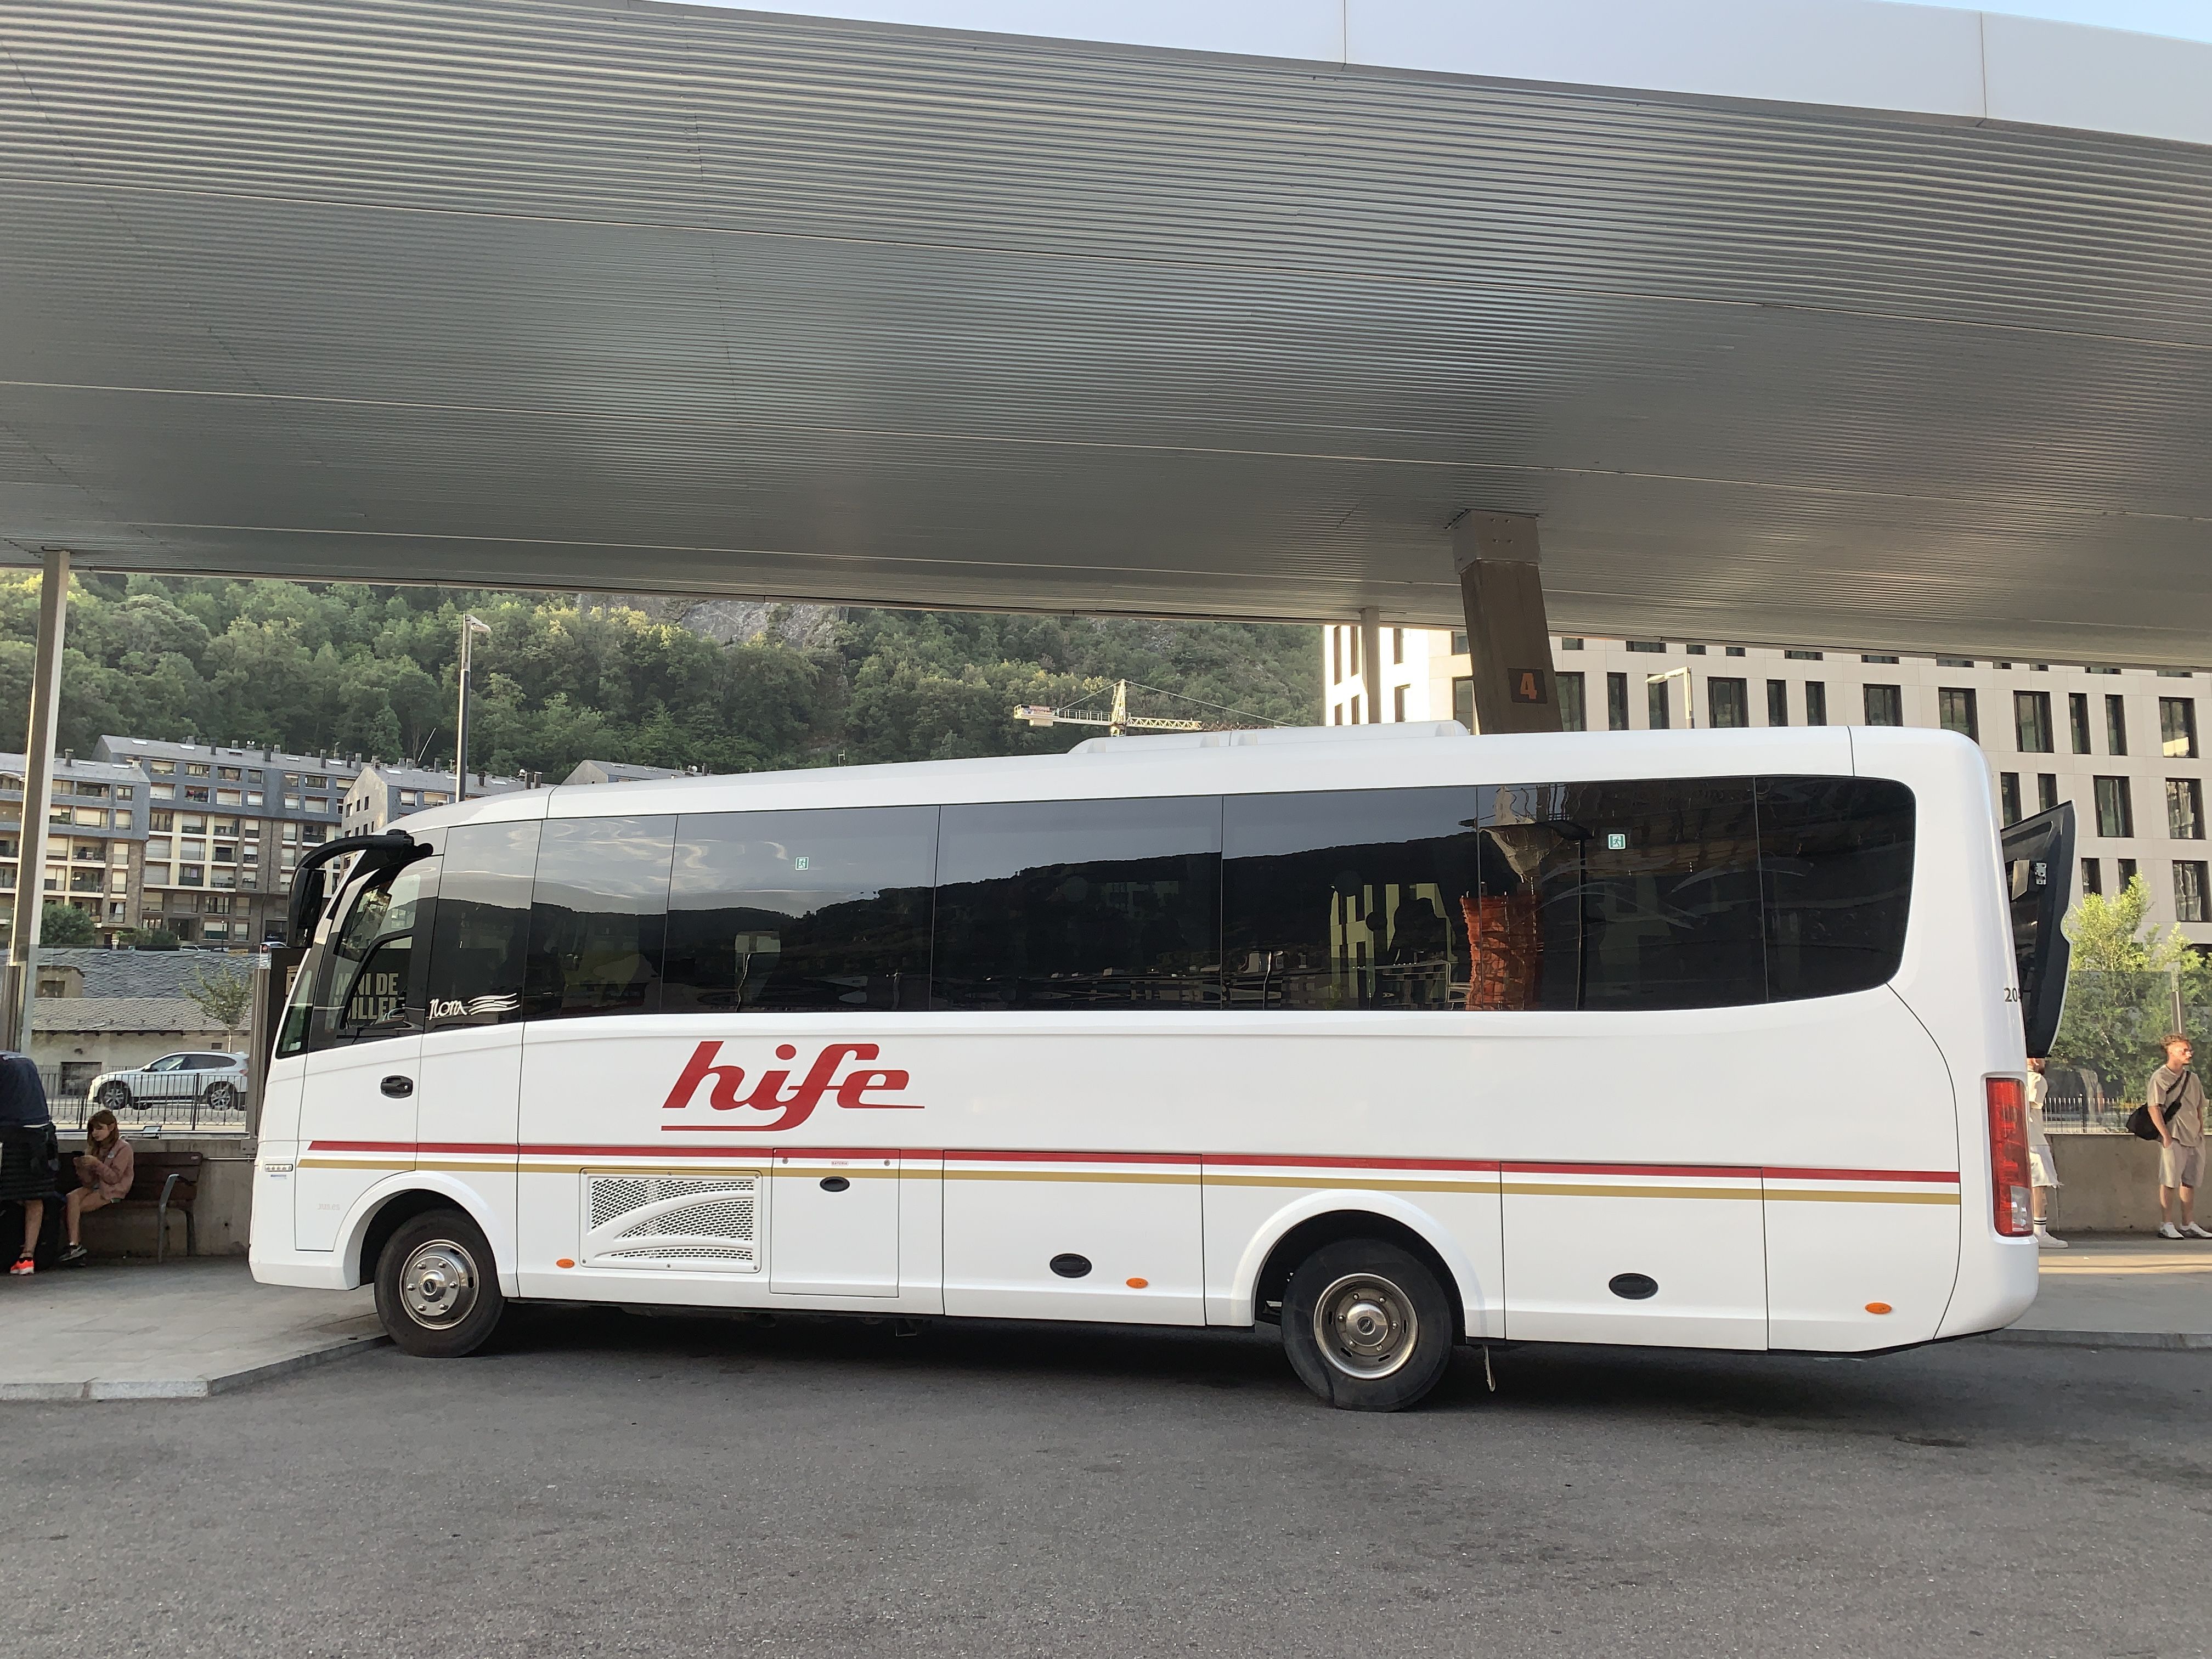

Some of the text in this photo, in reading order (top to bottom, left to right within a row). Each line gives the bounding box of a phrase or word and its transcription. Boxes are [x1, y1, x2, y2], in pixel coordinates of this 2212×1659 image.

[1520, 673, 1537, 699] 4
[375, 973, 399, 996] DE
[2004, 988, 2020, 1002] 20
[661, 1041, 926, 1132] hife
